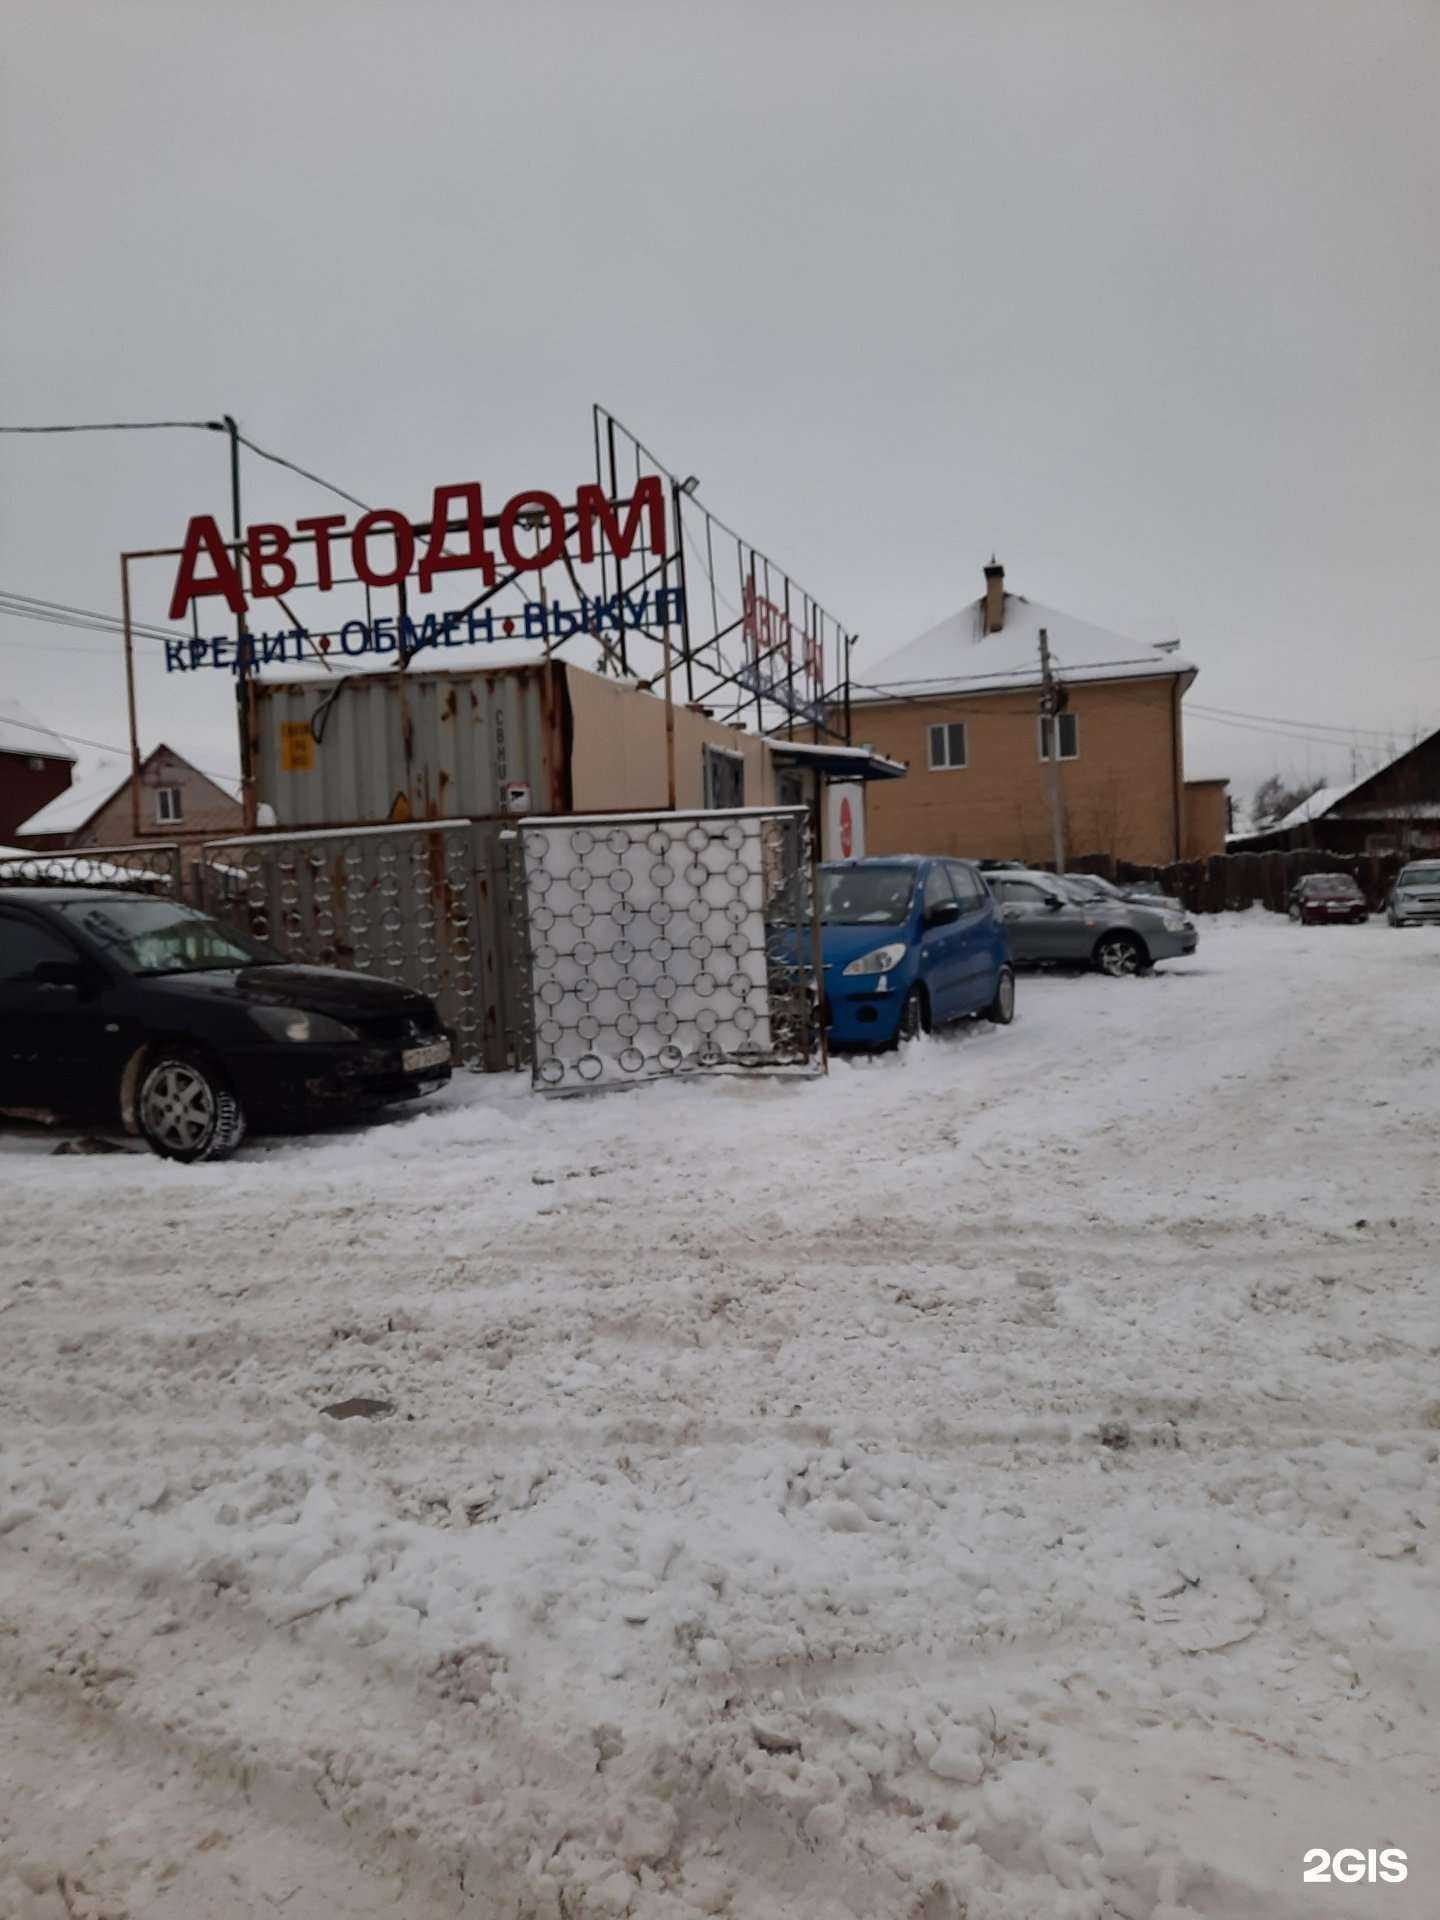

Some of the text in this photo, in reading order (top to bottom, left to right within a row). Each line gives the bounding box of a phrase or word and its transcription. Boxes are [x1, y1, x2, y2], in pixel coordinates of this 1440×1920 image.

[165, 587, 685, 675] КРЕДИТ ОБМЕН ВЫКУП
